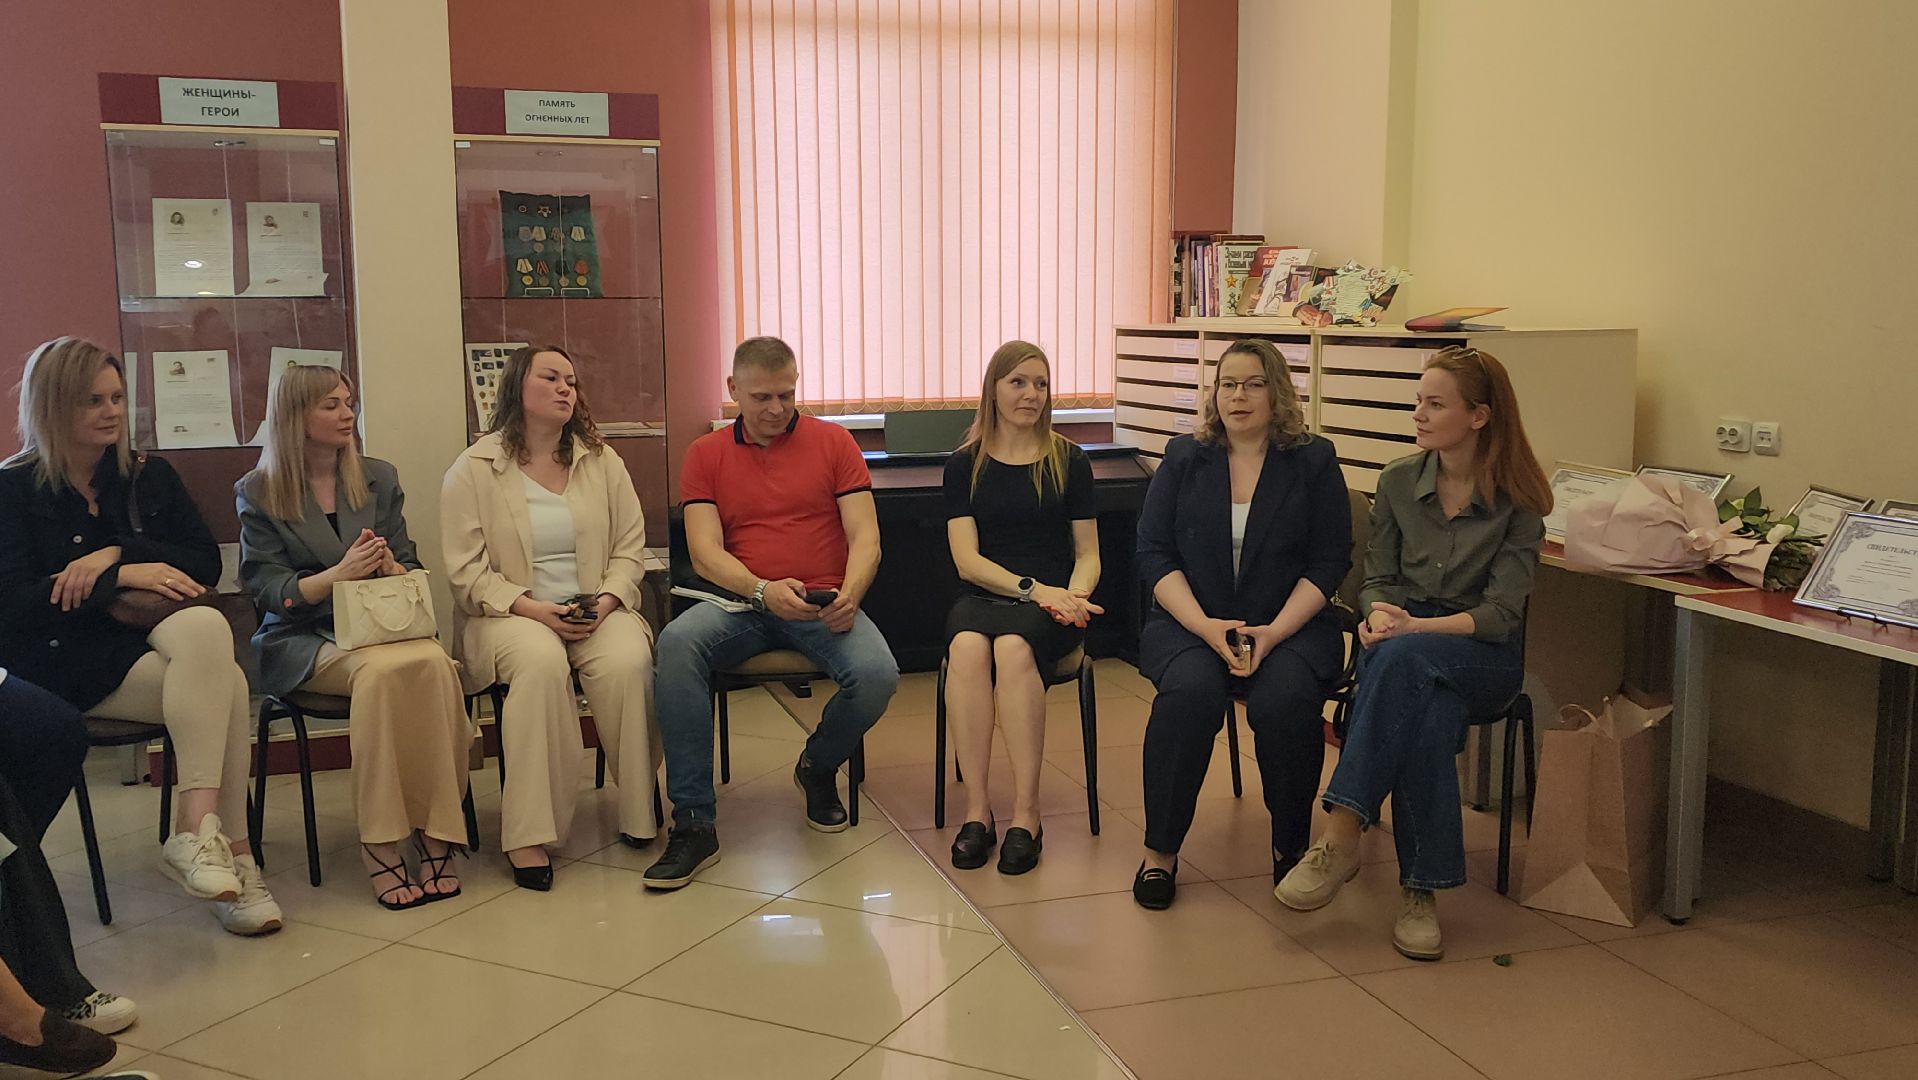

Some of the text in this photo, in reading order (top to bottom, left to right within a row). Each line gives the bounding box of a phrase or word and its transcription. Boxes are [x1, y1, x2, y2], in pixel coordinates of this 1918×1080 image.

[182, 87, 256, 99] ЖЕНЩИНЫ-
[538, 100, 576, 108] ПАМЯТЬ
[201, 106, 240, 117] ГЕРОИ
[525, 114, 590, 124] ОГНЕННЫХ ЛЕТ
[1866, 543, 1918, 556] СВИДЕТЕЛЬСТ
